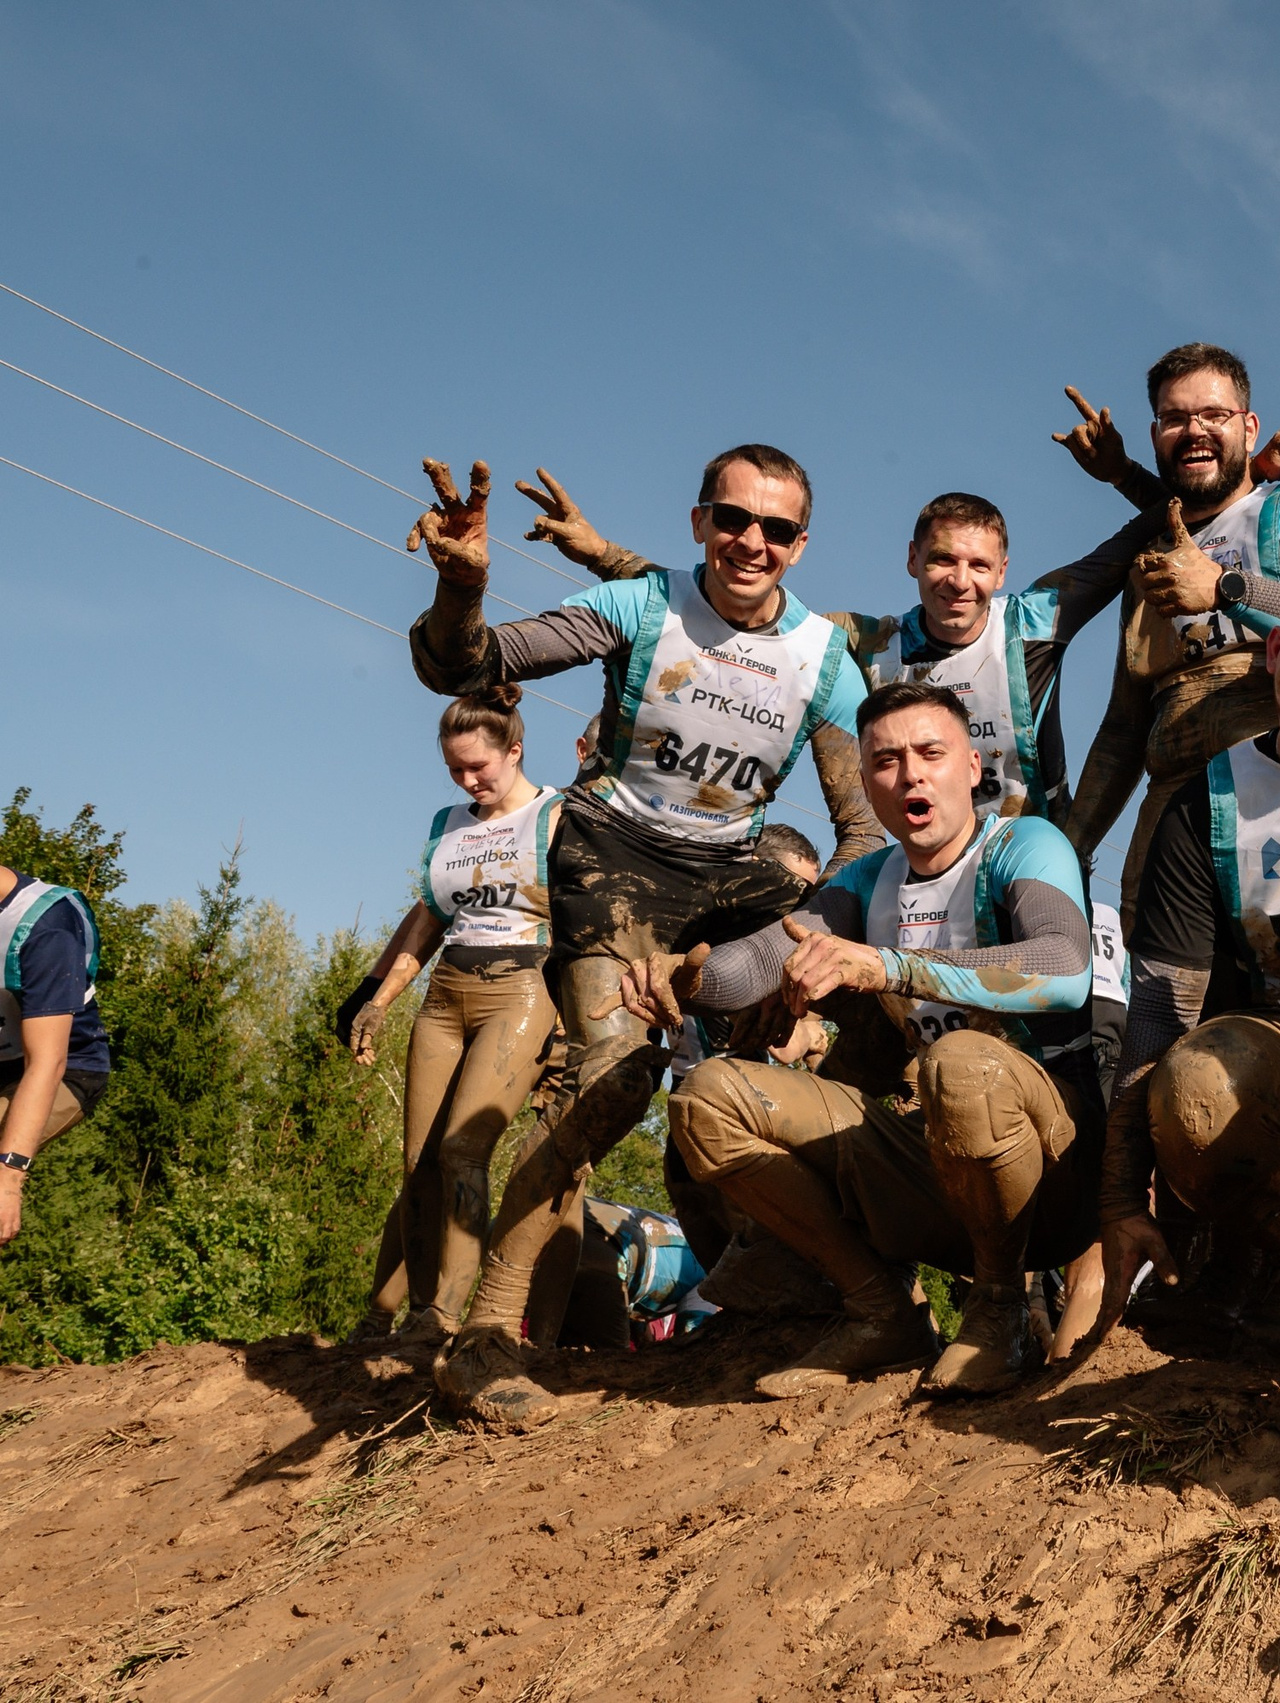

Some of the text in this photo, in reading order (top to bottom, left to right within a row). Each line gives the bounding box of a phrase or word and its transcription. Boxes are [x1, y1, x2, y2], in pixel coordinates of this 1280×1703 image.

[701, 645, 778, 676] ГОНКА ГЕРОЕВ
[691, 688, 786, 732] РТК-ЦОД
[655, 731, 761, 791] 6470
[669, 803, 731, 823] ГАЗПРОМБАНК
[445, 848, 519, 872] mindbox
[907, 910, 949, 923] ГЕРОЕВ
[1092, 932, 1115, 961] 15
